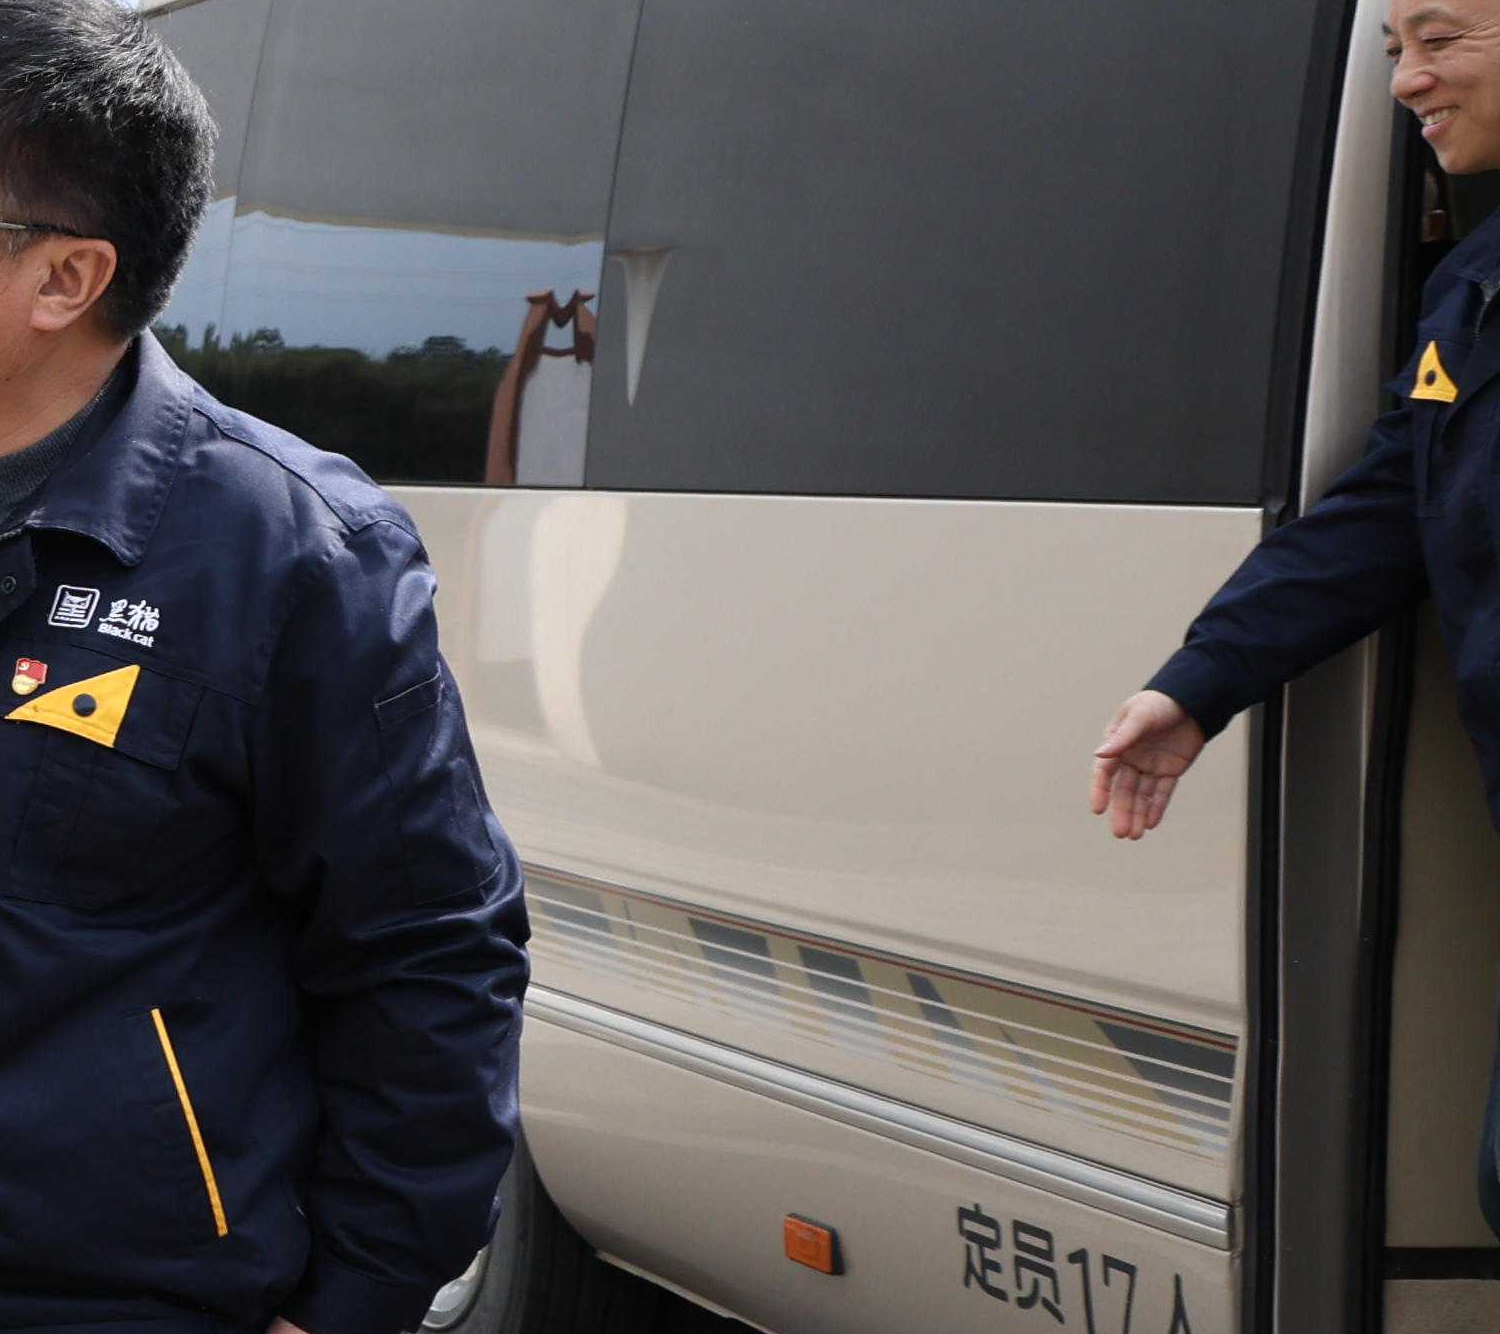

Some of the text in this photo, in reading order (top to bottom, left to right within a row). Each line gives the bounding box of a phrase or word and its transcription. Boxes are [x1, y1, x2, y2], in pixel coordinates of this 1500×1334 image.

[99, 599, 160, 632] 黑猫
[97, 623, 155, 648] Black cat
